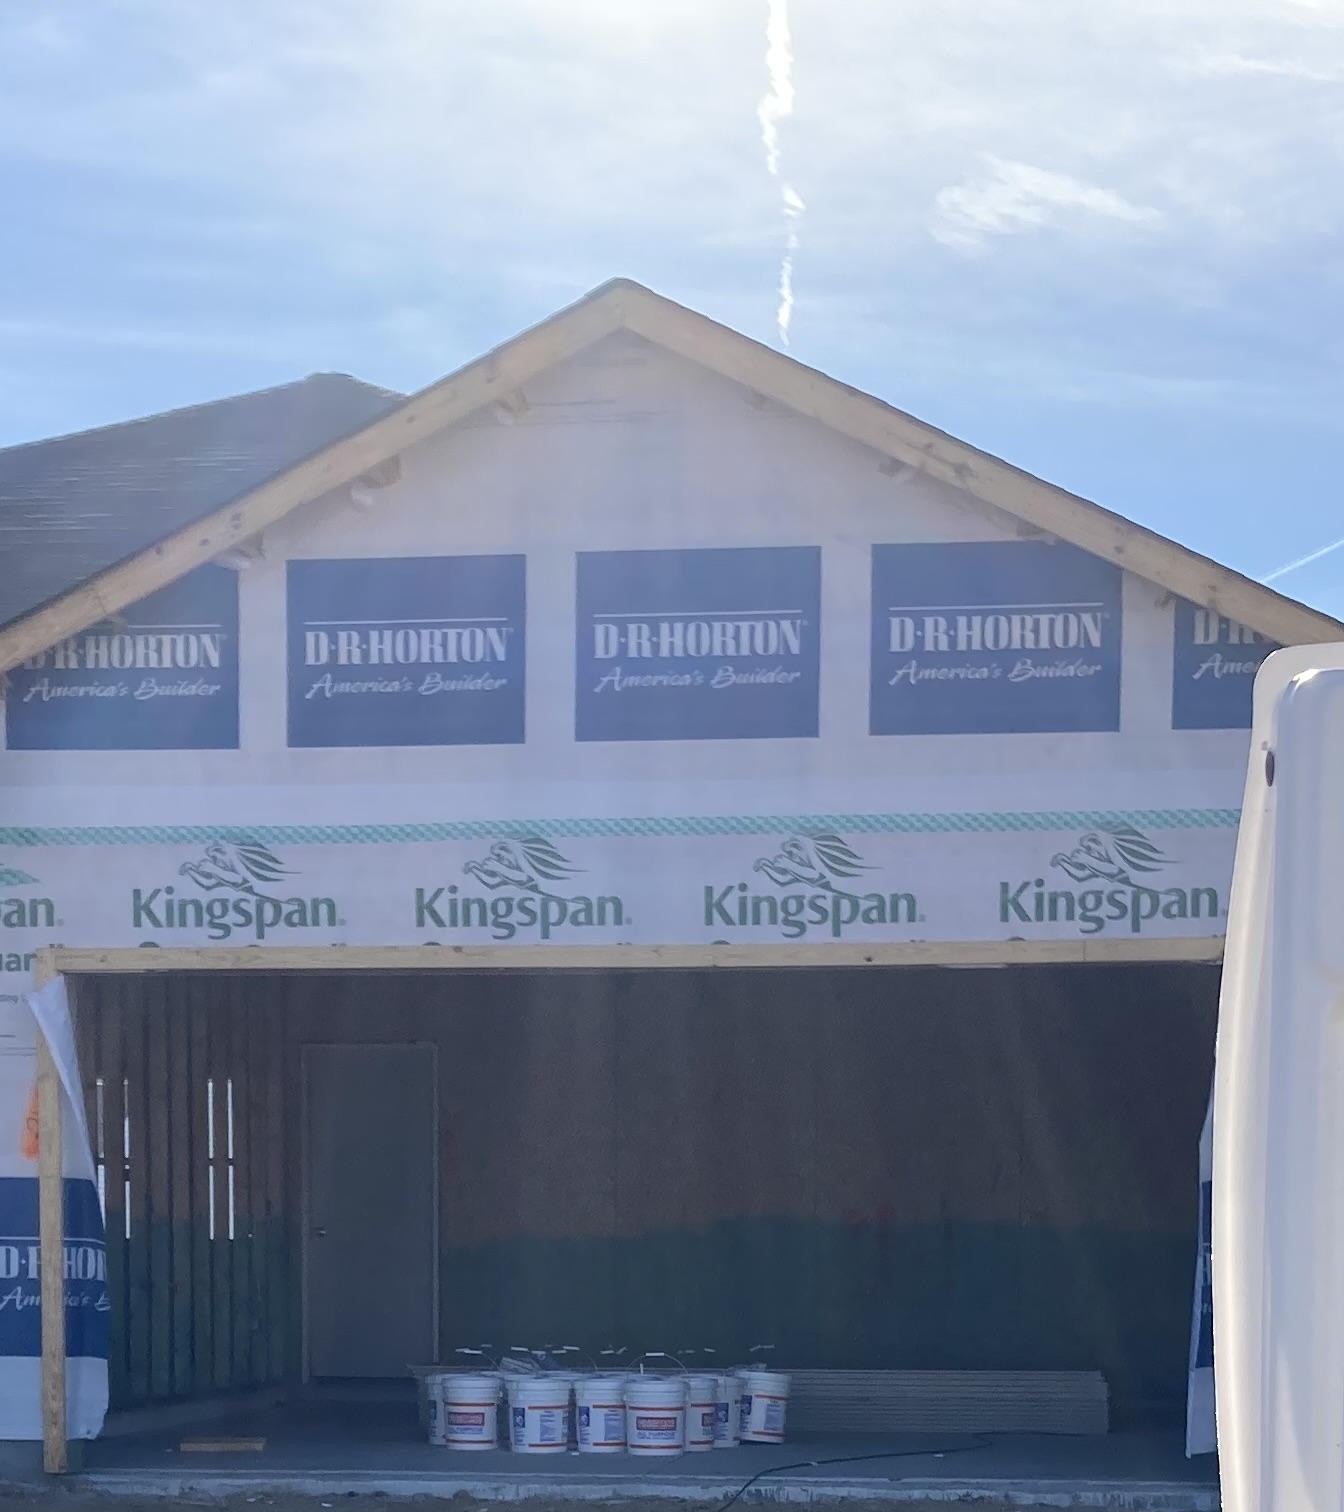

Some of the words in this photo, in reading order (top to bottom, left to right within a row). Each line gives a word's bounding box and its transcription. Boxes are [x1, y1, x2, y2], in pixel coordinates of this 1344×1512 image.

[134, 678, 222, 701] Builder
[305, 672, 413, 700] America's
[419, 672, 509, 695] Builder
[593, 664, 705, 693] America's
[710, 663, 801, 689] Builder
[888, 656, 1004, 686] America's
[1007, 656, 1103, 684] Builder
[132, 886, 338, 940] Kingspan
[415, 885, 624, 940] Kingspan
[703, 878, 917, 937] Kingspan
[1000, 877, 1219, 934] Kingspan
